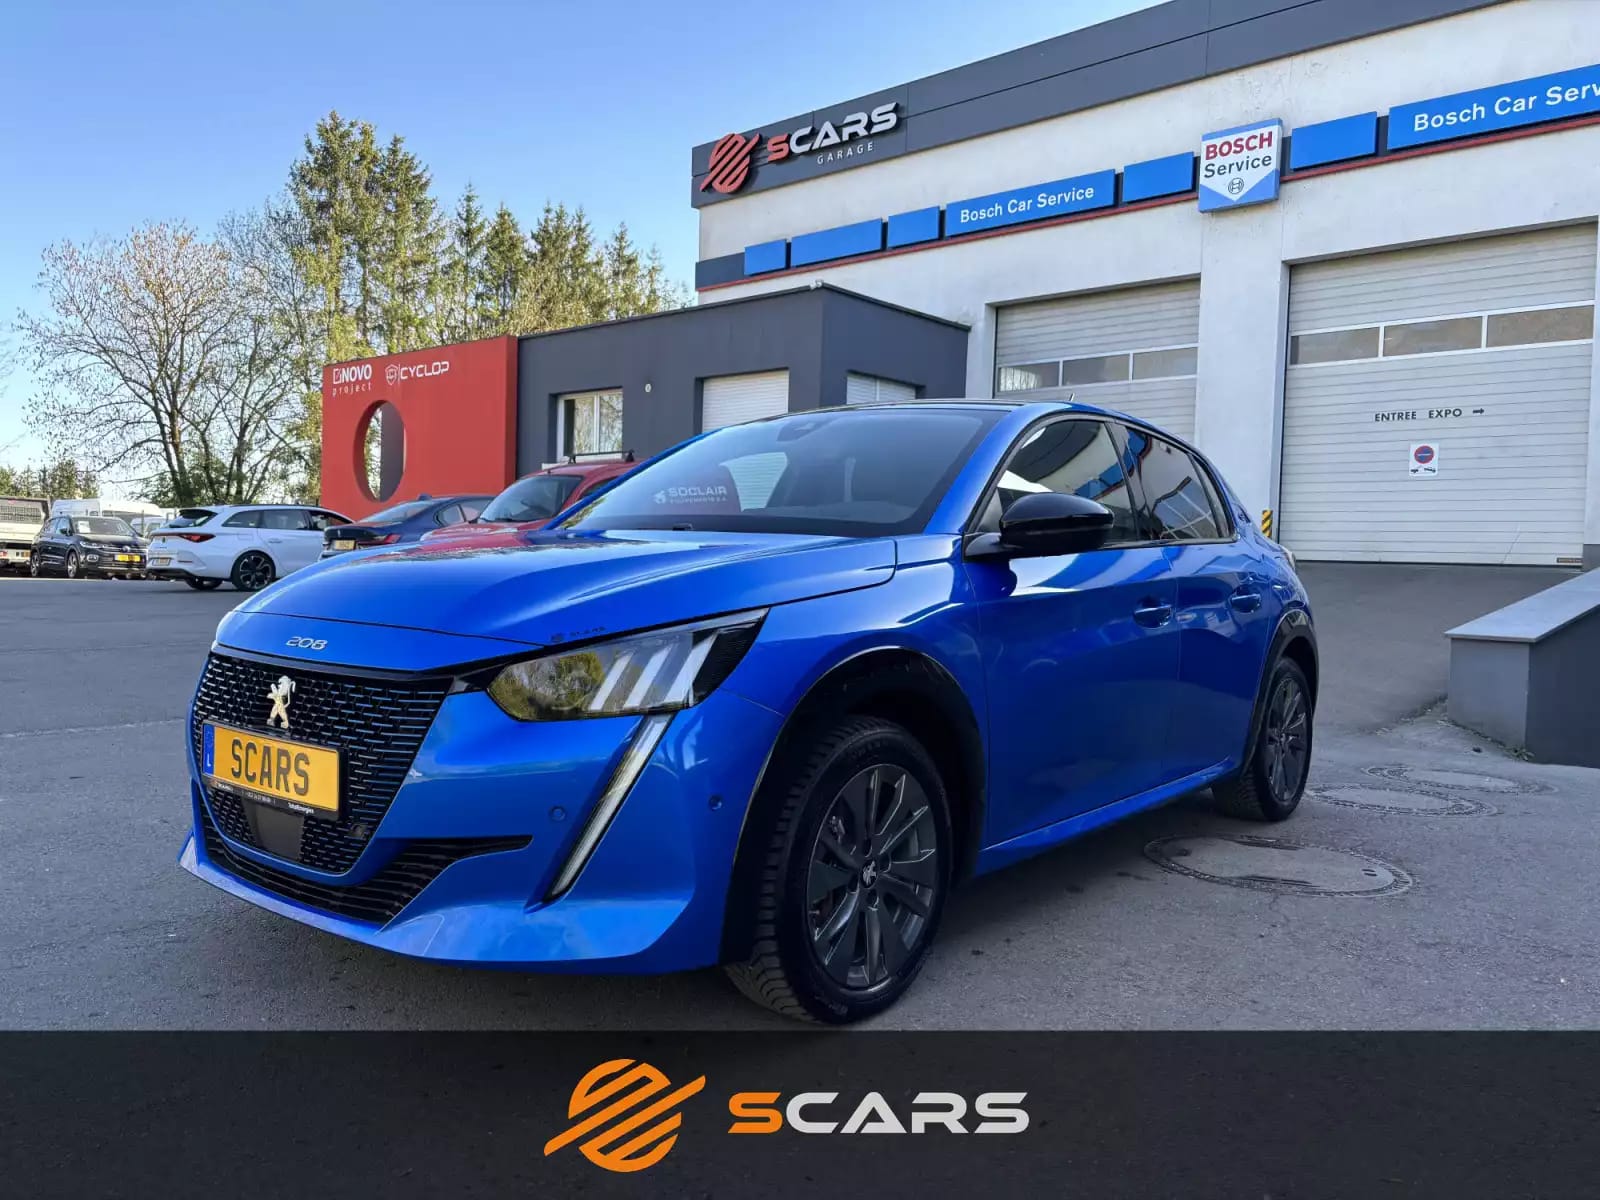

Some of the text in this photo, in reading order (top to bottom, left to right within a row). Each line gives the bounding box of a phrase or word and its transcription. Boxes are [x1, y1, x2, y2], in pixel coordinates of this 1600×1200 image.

[1413, 102, 1486, 132] Bosch
[1494, 94, 1537, 115] Car
[767, 102, 899, 163] SCARS
[817, 141, 874, 165] GARAGE
[1205, 131, 1273, 161] BOSCH
[1203, 153, 1272, 179] Service
[960, 185, 1095, 224] Bosch Car Service
[400, 361, 450, 380] CYCLOP
[332, 382, 371, 397] project
[1374, 408, 1463, 422] ENTREE EXPO
[285, 636, 328, 651] 208
[230, 738, 310, 797] SCARS
